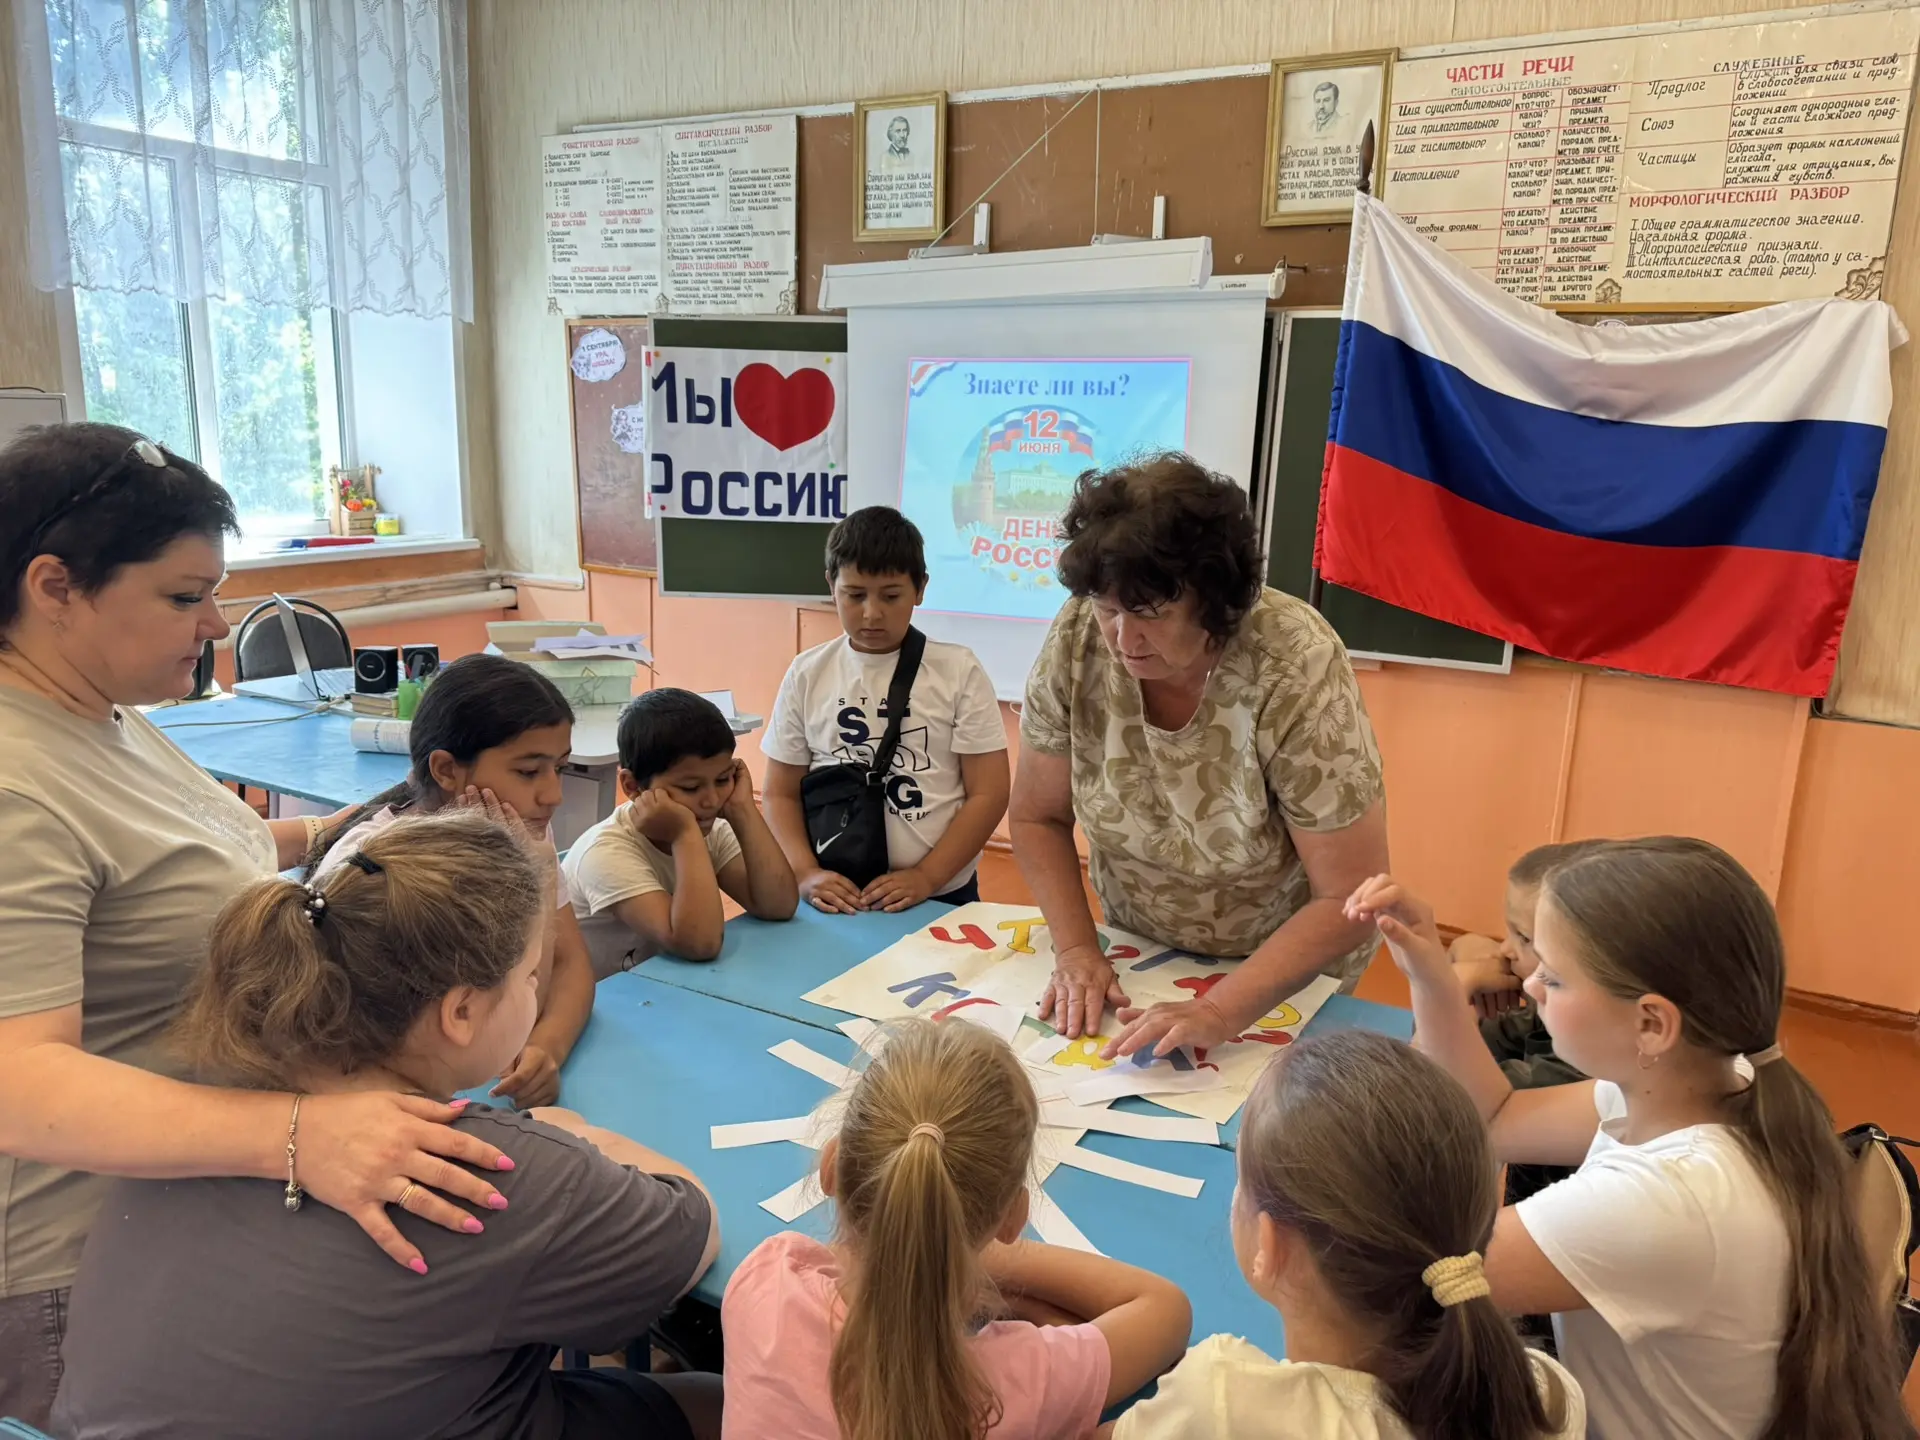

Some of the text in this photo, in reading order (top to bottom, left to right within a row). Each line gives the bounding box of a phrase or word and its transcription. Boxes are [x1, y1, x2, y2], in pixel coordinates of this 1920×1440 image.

[1447, 56, 1574, 83] ЧАСТИ РЕЧИ
[1714, 55, 1805, 73] СЛУЖЕБНЫЕ
[1795, 65, 1818, 75] для
[1825, 61, 1864, 70] связи
[1872, 54, 1898, 65] слов
[1648, 80, 1706, 97] Предлог
[1399, 98, 1512, 116] Имя существительное
[1732, 104, 1797, 117] Соединяет
[1800, 99, 1870, 113] однородные
[745, 125, 772, 133] РАЗБОР
[1396, 119, 1499, 135] Имя прилагательное
[1642, 118, 1674, 131] Союз
[1421, 139, 1486, 152] числительное
[1729, 141, 1782, 155] Образует
[1787, 139, 1826, 152] формы
[1638, 152, 1696, 166] Частицы
[1391, 170, 1459, 182] Местоимение
[1776, 163, 1796, 173] для
[1630, 186, 1850, 208] МОРФОЛОГИЧЕСКИЙ РАЗБОР
[1680, 216, 1790, 235] грамматическое
[1630, 231, 1698, 243] Начальная
[1623, 266, 1722, 279] мостоятельных
[1729, 266, 1773, 277] частей
[964, 373, 1130, 396] Знаете ли вы?
[1024, 410, 1059, 437] 12
[1019, 441, 1060, 453] ИЮНЯ
